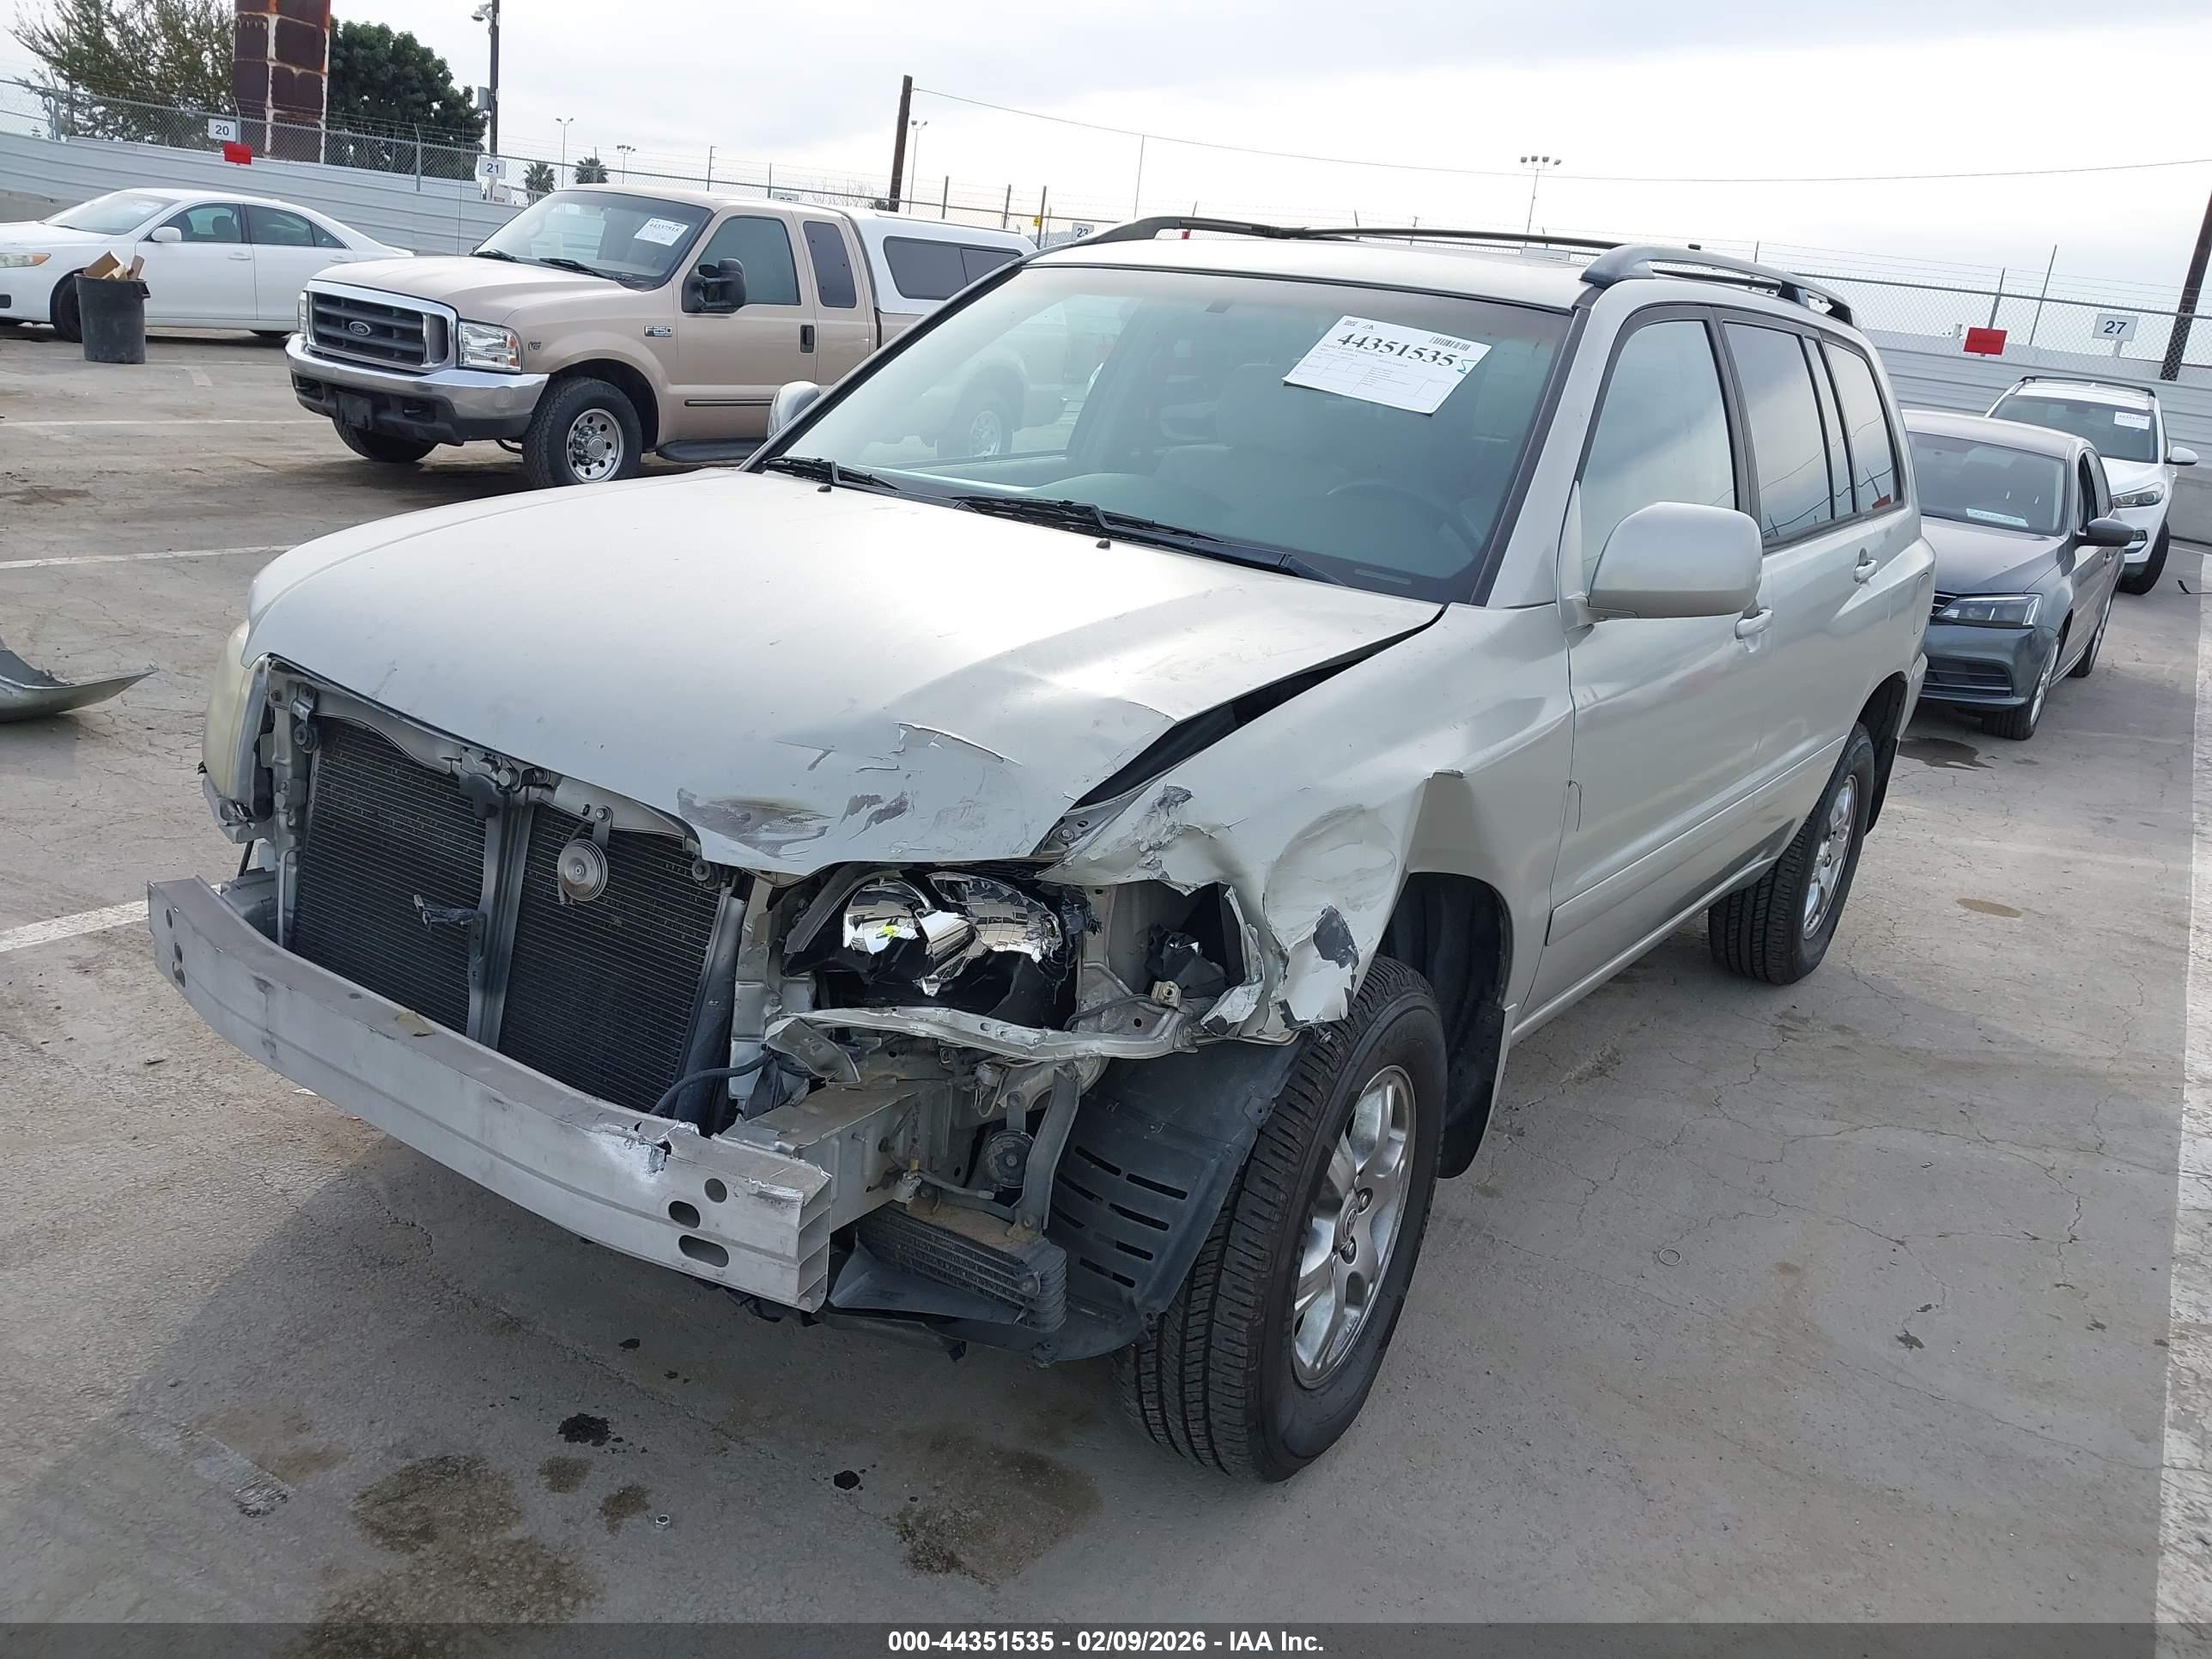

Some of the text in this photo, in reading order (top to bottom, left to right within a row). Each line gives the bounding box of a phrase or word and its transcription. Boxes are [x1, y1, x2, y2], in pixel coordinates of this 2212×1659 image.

[215, 125, 229, 136] 20
[486, 163, 499, 173] 21
[1077, 228, 1089, 238] 23
[2103, 320, 2127, 334] 27
[1337, 332, 1459, 367] 44351535
